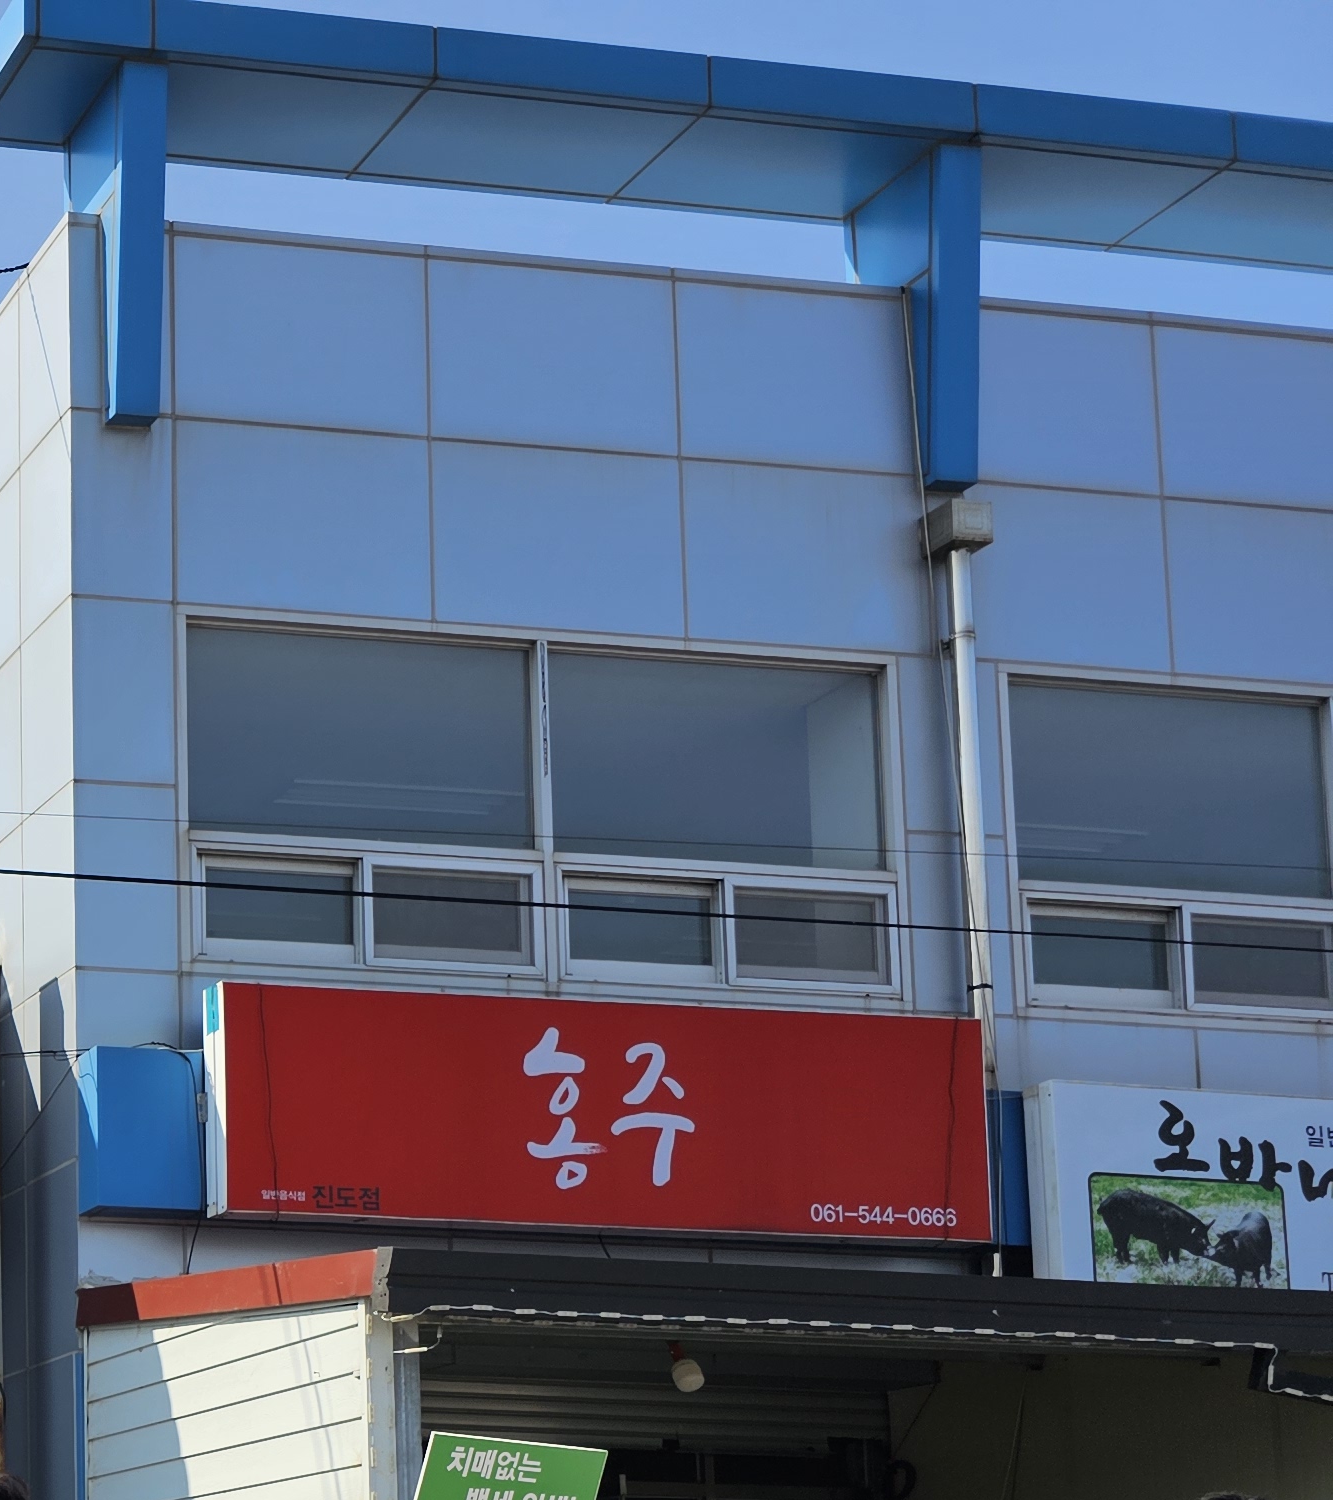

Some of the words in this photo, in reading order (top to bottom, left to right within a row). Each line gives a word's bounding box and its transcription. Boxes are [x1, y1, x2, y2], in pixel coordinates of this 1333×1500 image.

[523, 1026, 696, 1190] 홍주
[261, 1190, 305, 1201] 일반음식점
[313, 1185, 379, 1210] 진도점
[810, 1203, 957, 1227] 061-544-0666
[446, 1446, 542, 1483] 치매없는
